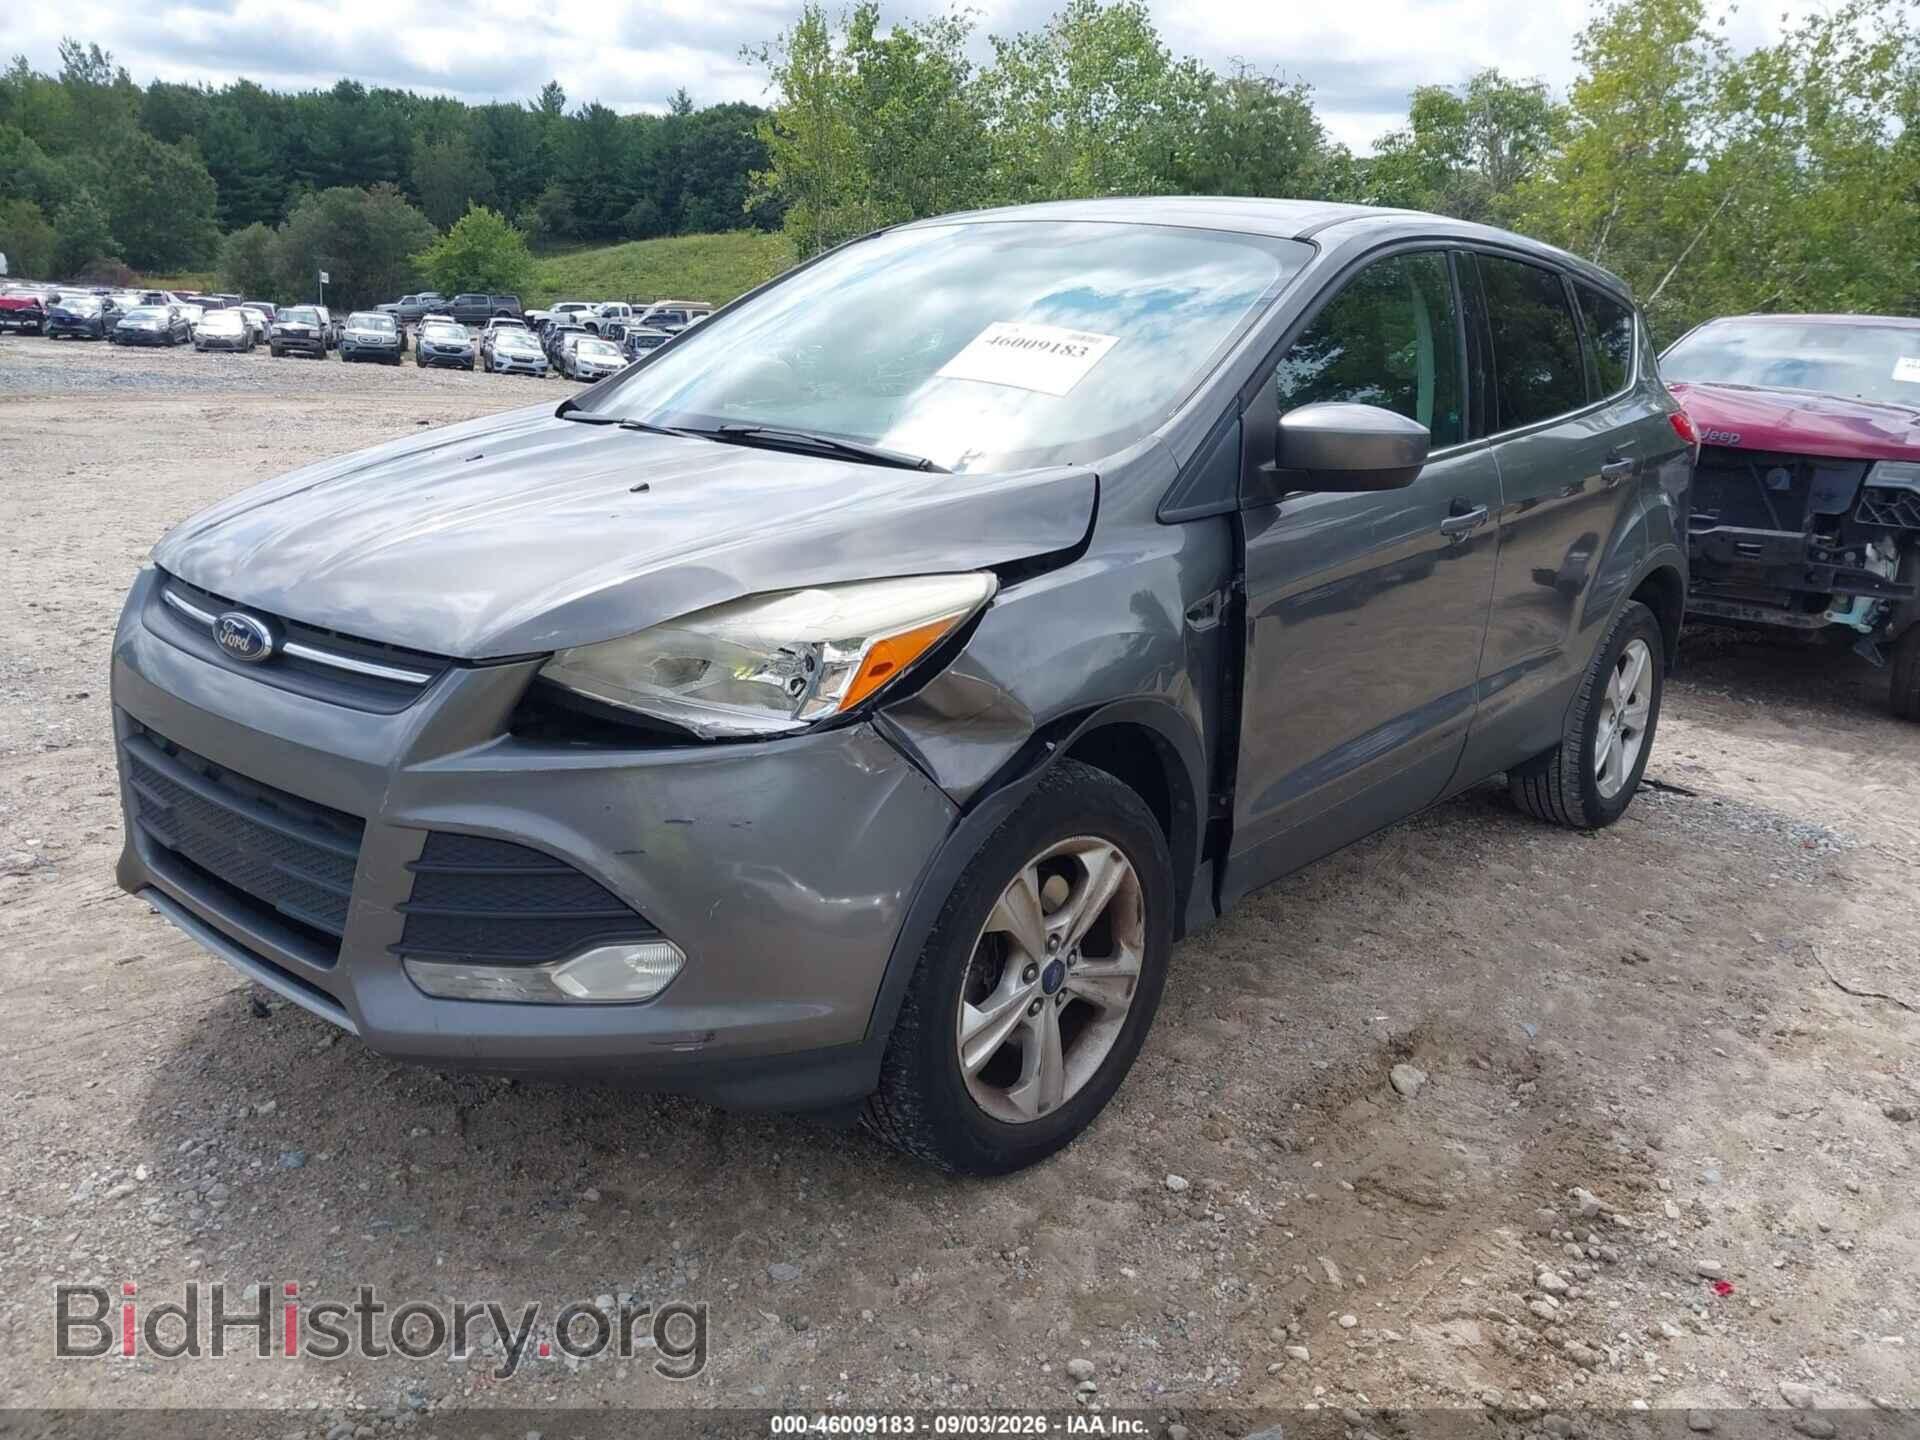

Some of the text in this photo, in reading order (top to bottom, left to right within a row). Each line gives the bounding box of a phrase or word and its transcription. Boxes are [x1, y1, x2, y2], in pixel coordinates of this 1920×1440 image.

[986, 335, 1089, 357] 46009183
[1700, 427, 1741, 446] Jeep
[219, 618, 251, 652] Ford
